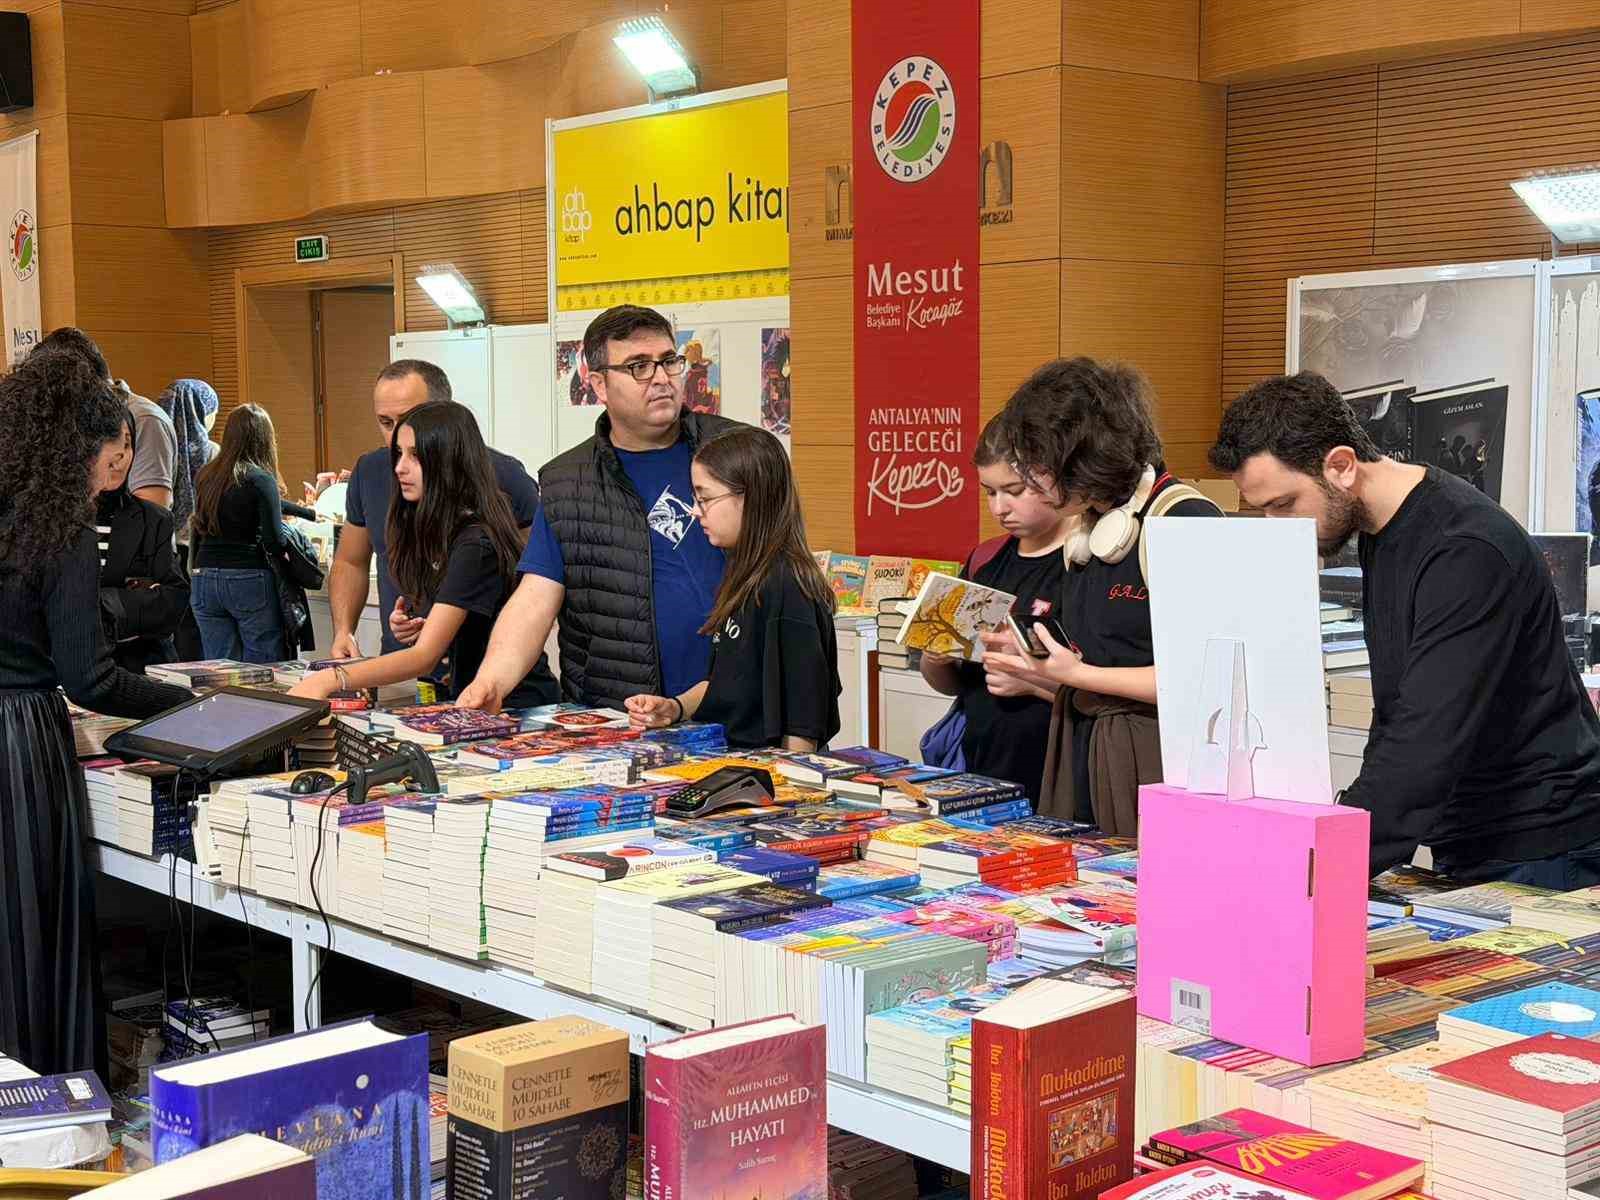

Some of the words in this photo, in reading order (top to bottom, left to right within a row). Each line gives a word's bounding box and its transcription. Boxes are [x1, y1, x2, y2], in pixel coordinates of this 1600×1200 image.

[876, 61, 949, 110] KEPEZ
[615, 182, 714, 243] ahbap
[301, 240, 318, 248] EXIT
[867, 258, 964, 298] Mesut
[866, 303, 901, 317] Belediye
[905, 297, 963, 333] Kocagöz
[868, 407, 961, 425] ANTALYA'NIN
[868, 428, 961, 452] GELECEĞİ
[867, 453, 938, 517] Kepez
[874, 567, 905, 579] SUDOKU
[512, 1067, 572, 1091] CENNETLE
[1040, 1054, 1126, 1097] Mukaddime
[513, 1108, 526, 1122] 10
[529, 1097, 571, 1121] SAHABE
[710, 1086, 810, 1127] MUHAMMED
[730, 1118, 785, 1148] HAYATI
